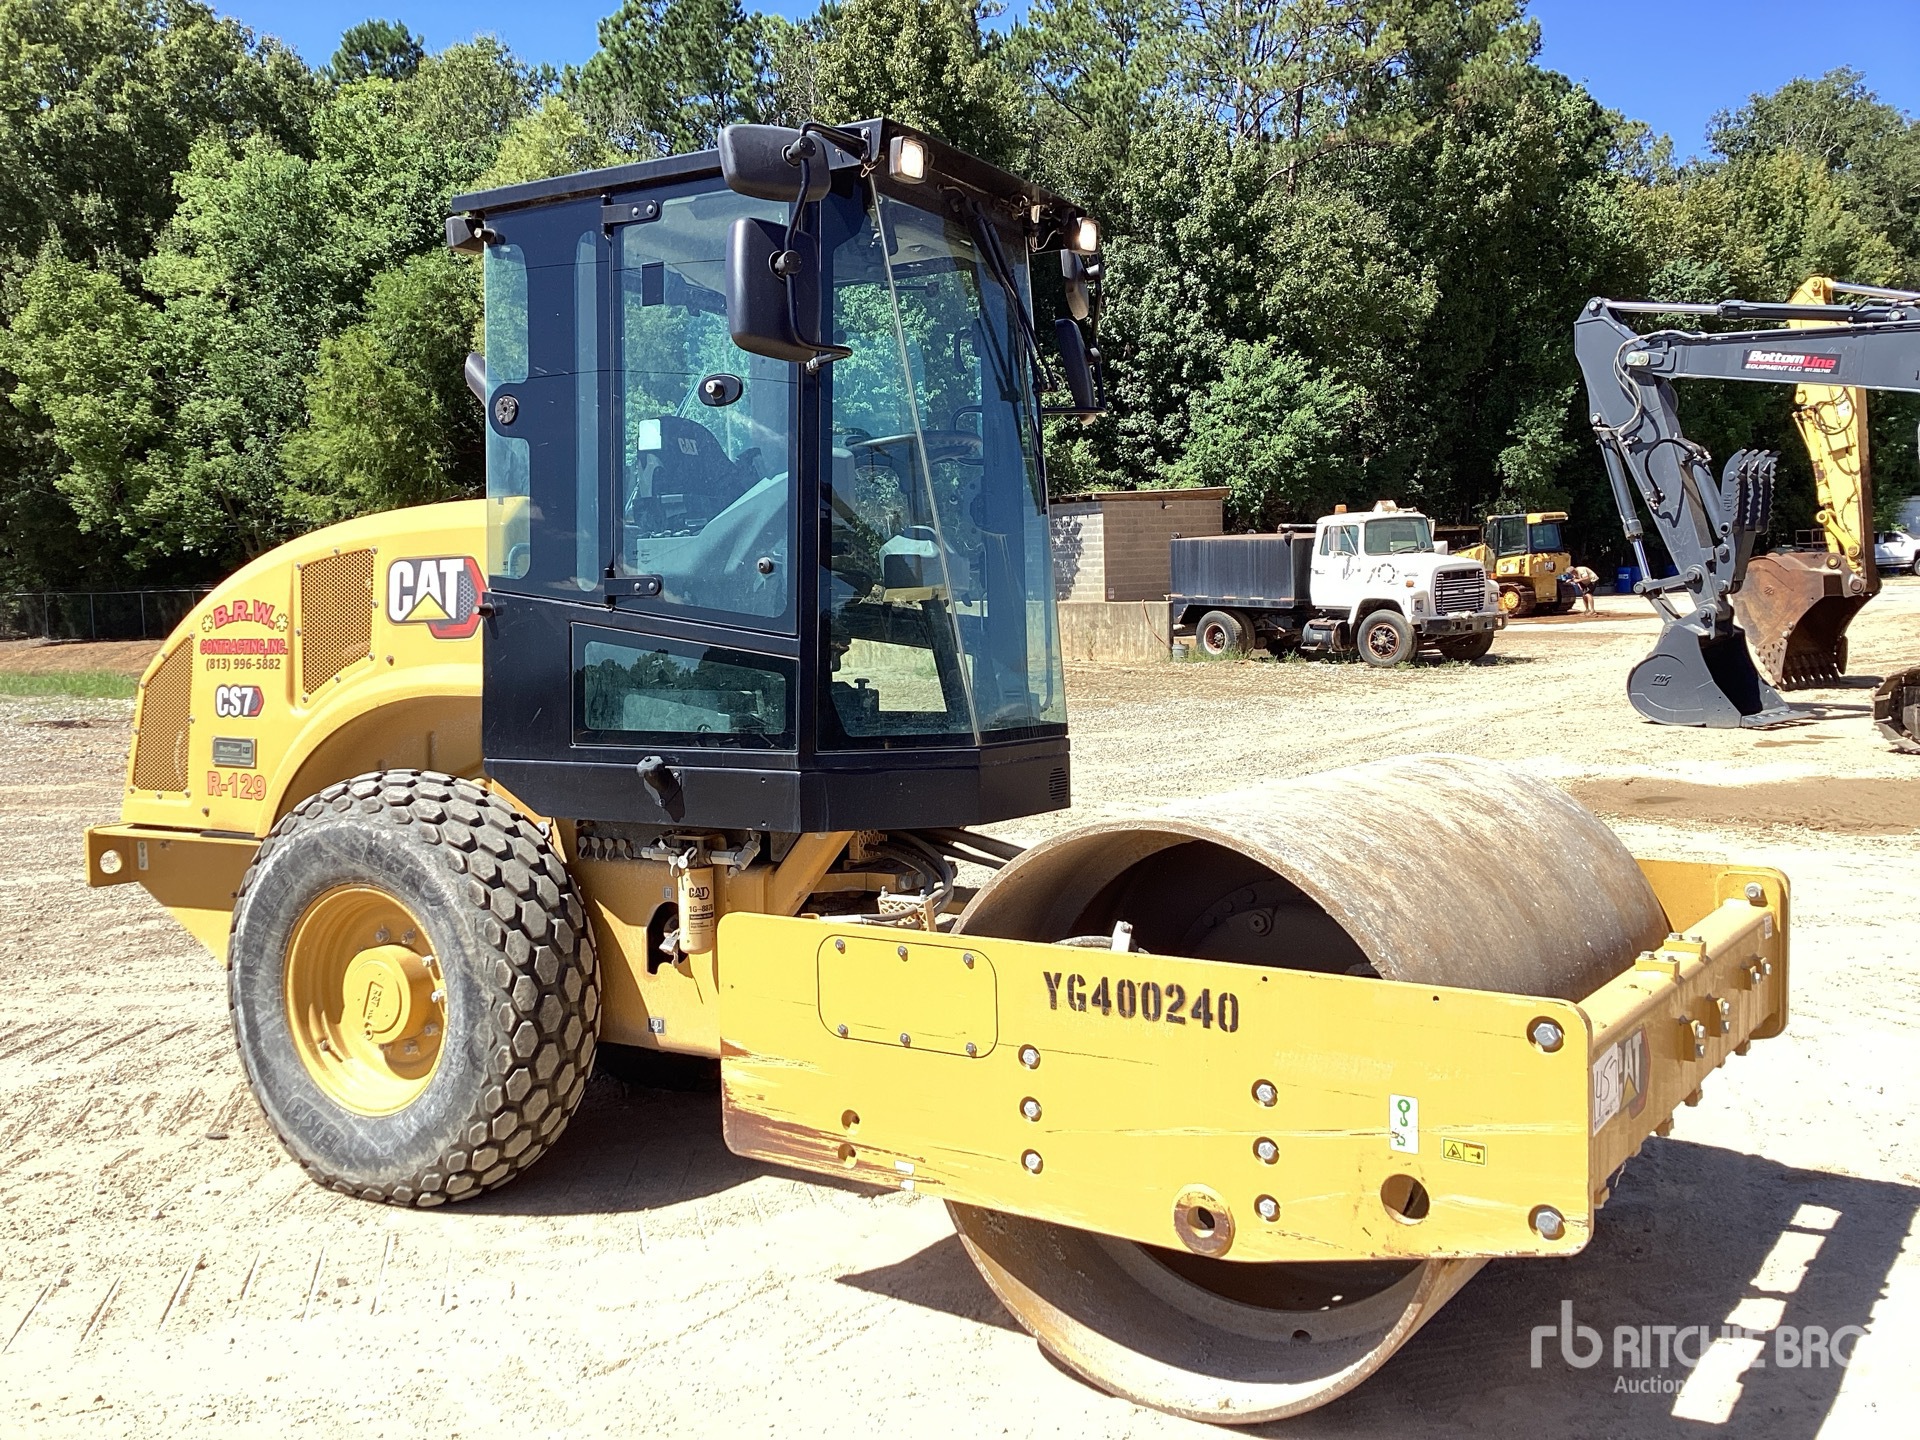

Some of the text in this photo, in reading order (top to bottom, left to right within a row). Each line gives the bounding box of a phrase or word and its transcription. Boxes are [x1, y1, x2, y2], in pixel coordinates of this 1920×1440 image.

[388, 559, 464, 621] CAT
[213, 599, 275, 630] B.R.W.
[206, 658, 281, 671] (813) 996-5882
[216, 686, 254, 717] CS7
[207, 771, 267, 801] R-129
[689, 887, 707, 899] CAT
[1042, 971, 1239, 1033] YG400240
